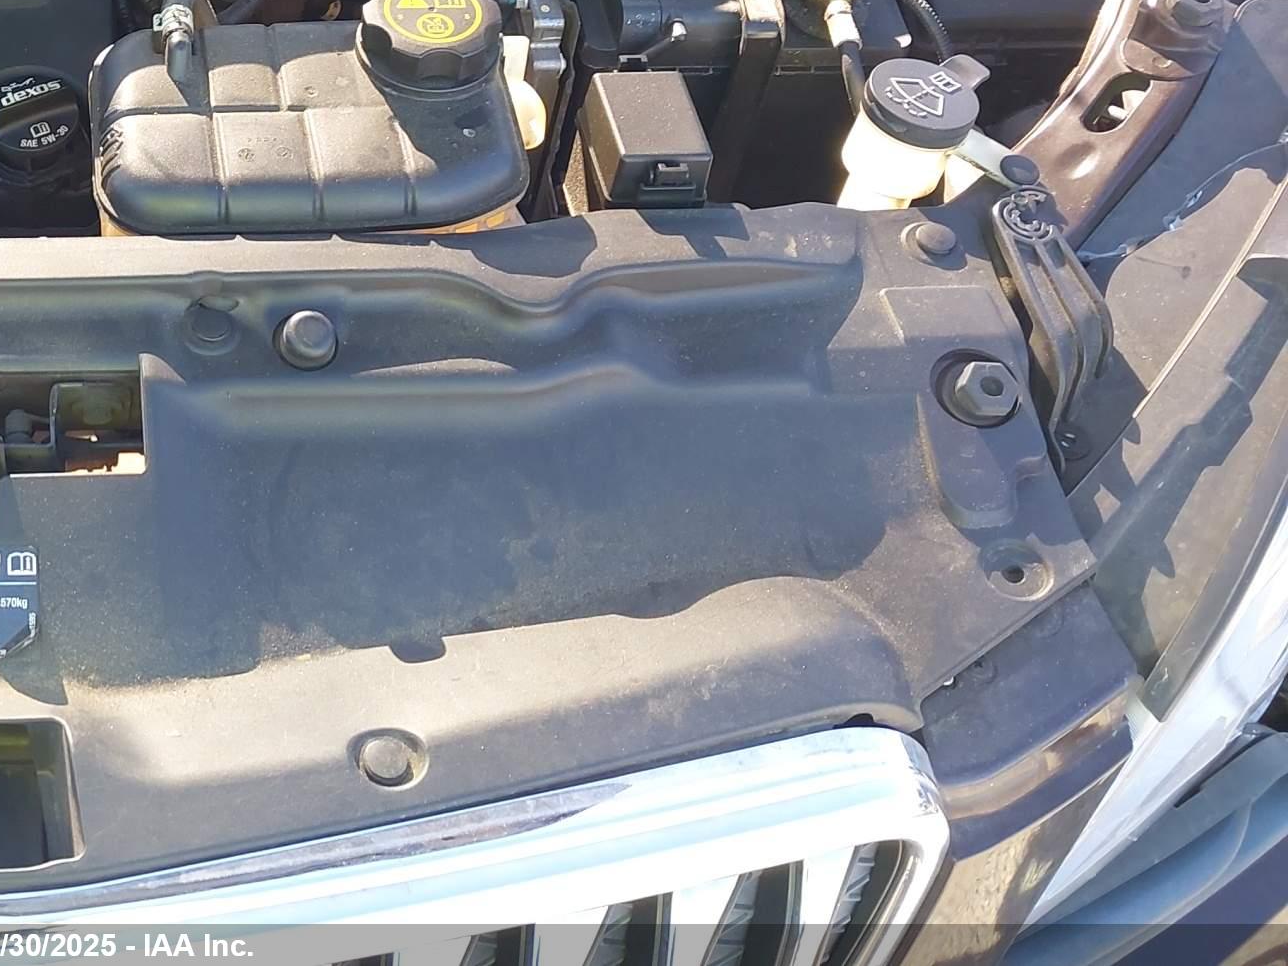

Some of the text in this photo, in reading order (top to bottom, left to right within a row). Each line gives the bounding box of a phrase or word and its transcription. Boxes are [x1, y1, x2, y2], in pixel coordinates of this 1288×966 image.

[0, 79, 62, 107] dexos
[20, 124, 69, 148] SAE 5W-30
